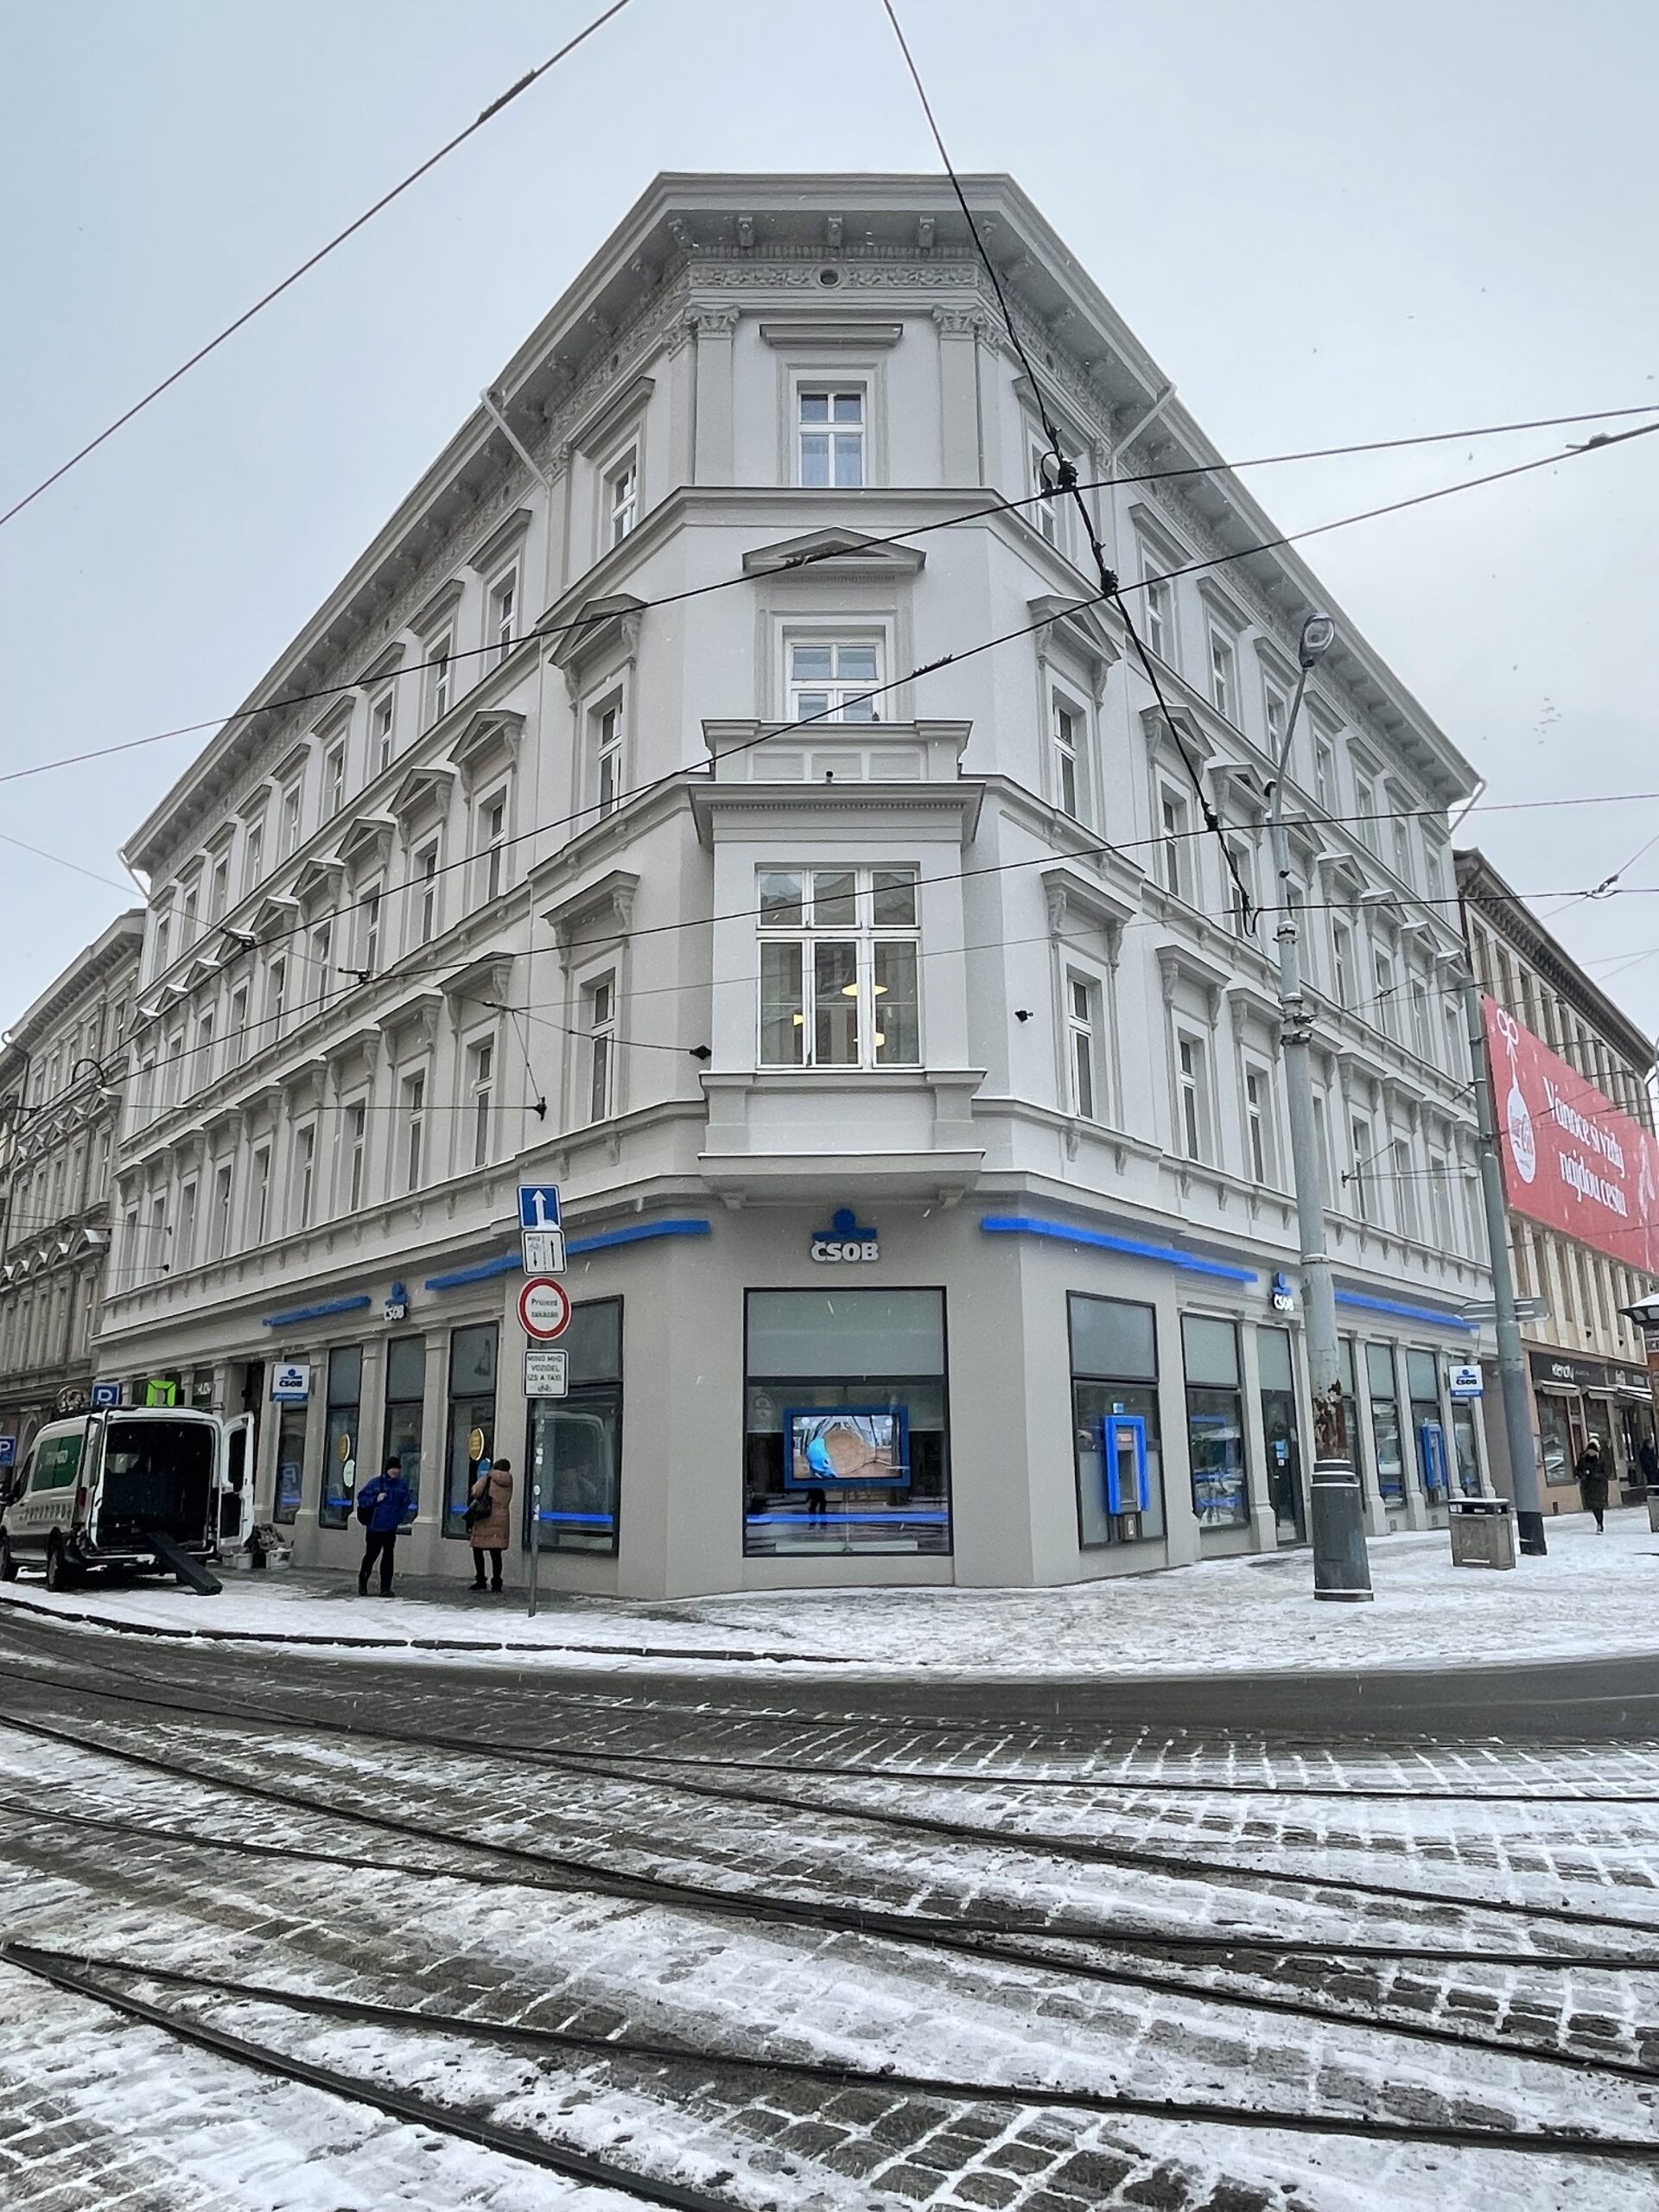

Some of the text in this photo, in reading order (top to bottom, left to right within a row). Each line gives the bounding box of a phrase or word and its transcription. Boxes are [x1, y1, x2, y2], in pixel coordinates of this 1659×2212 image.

[1542, 1076, 1591, 1147] Vánoce
[1559, 1149, 1601, 1203] najdou
[810, 1240, 879, 1262] ČSOB
[97, 1389, 113, 1405] P
